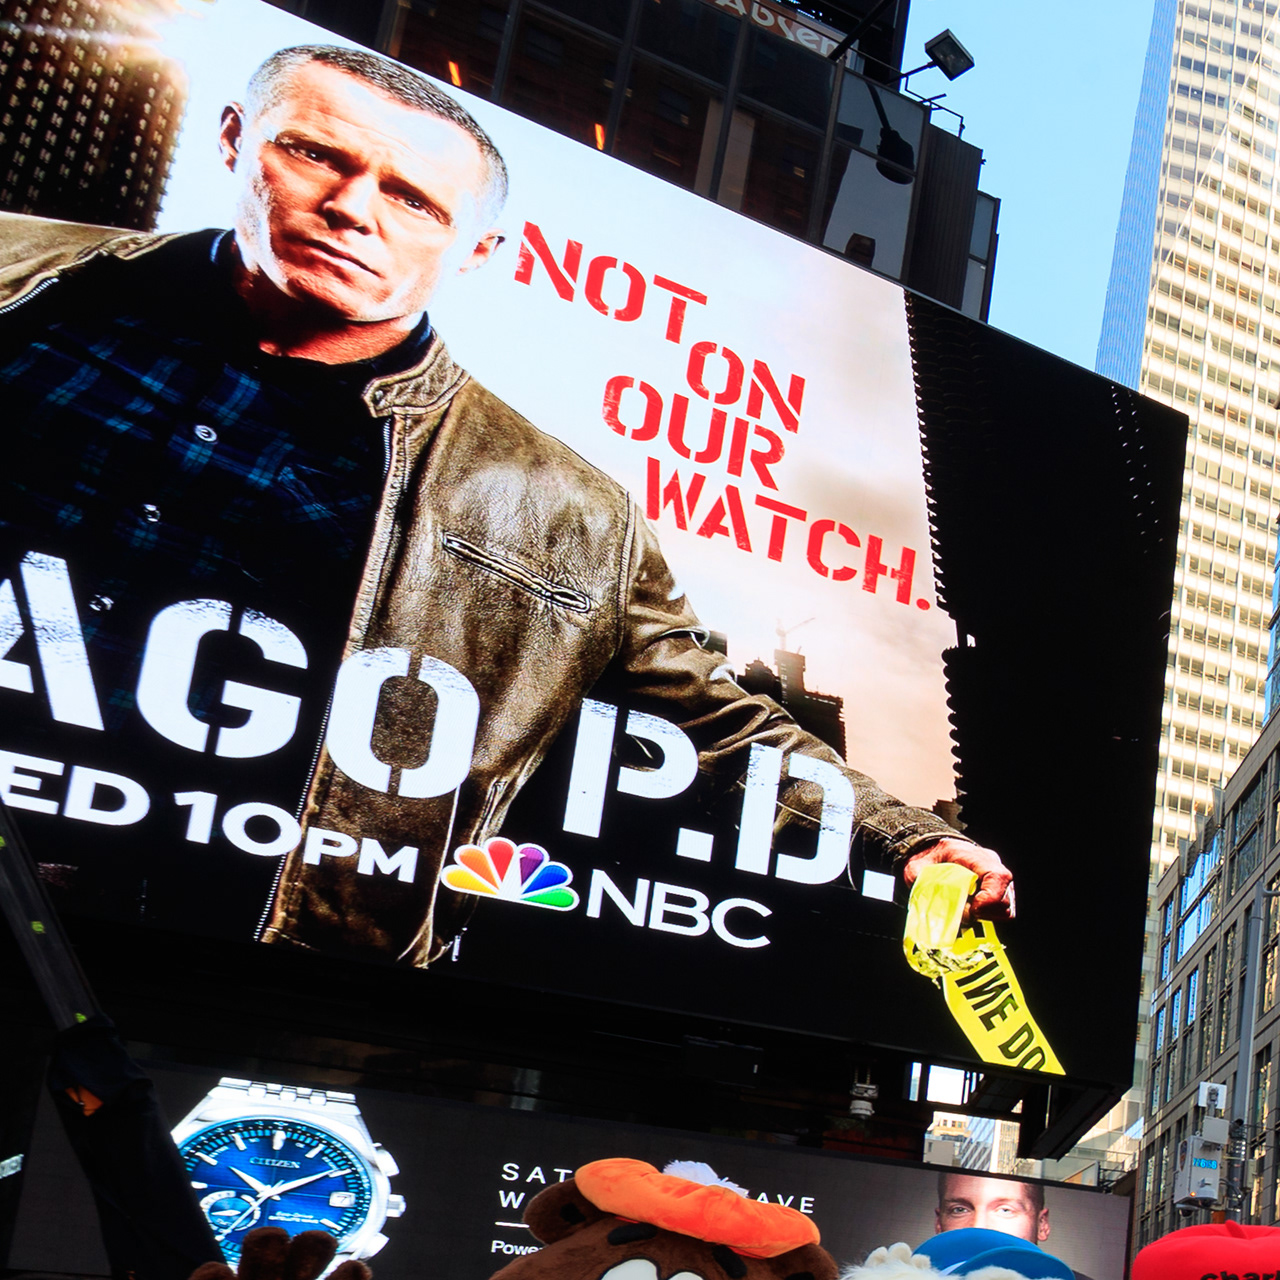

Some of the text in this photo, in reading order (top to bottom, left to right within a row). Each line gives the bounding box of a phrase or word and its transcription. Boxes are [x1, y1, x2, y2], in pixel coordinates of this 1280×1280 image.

[514, 221, 707, 344] NOT
[602, 375, 785, 491] OUR
[686, 341, 805, 434] ON
[646, 456, 930, 611] WATCH.
[174, 790, 418, 883] 10PM
[563, 697, 895, 902] P.D.
[587, 869, 772, 948] NBC
[955, 952, 1019, 1032] INE
[501, 1163, 816, 1213] SAT AVE
[491, 1240, 543, 1256] Powe
